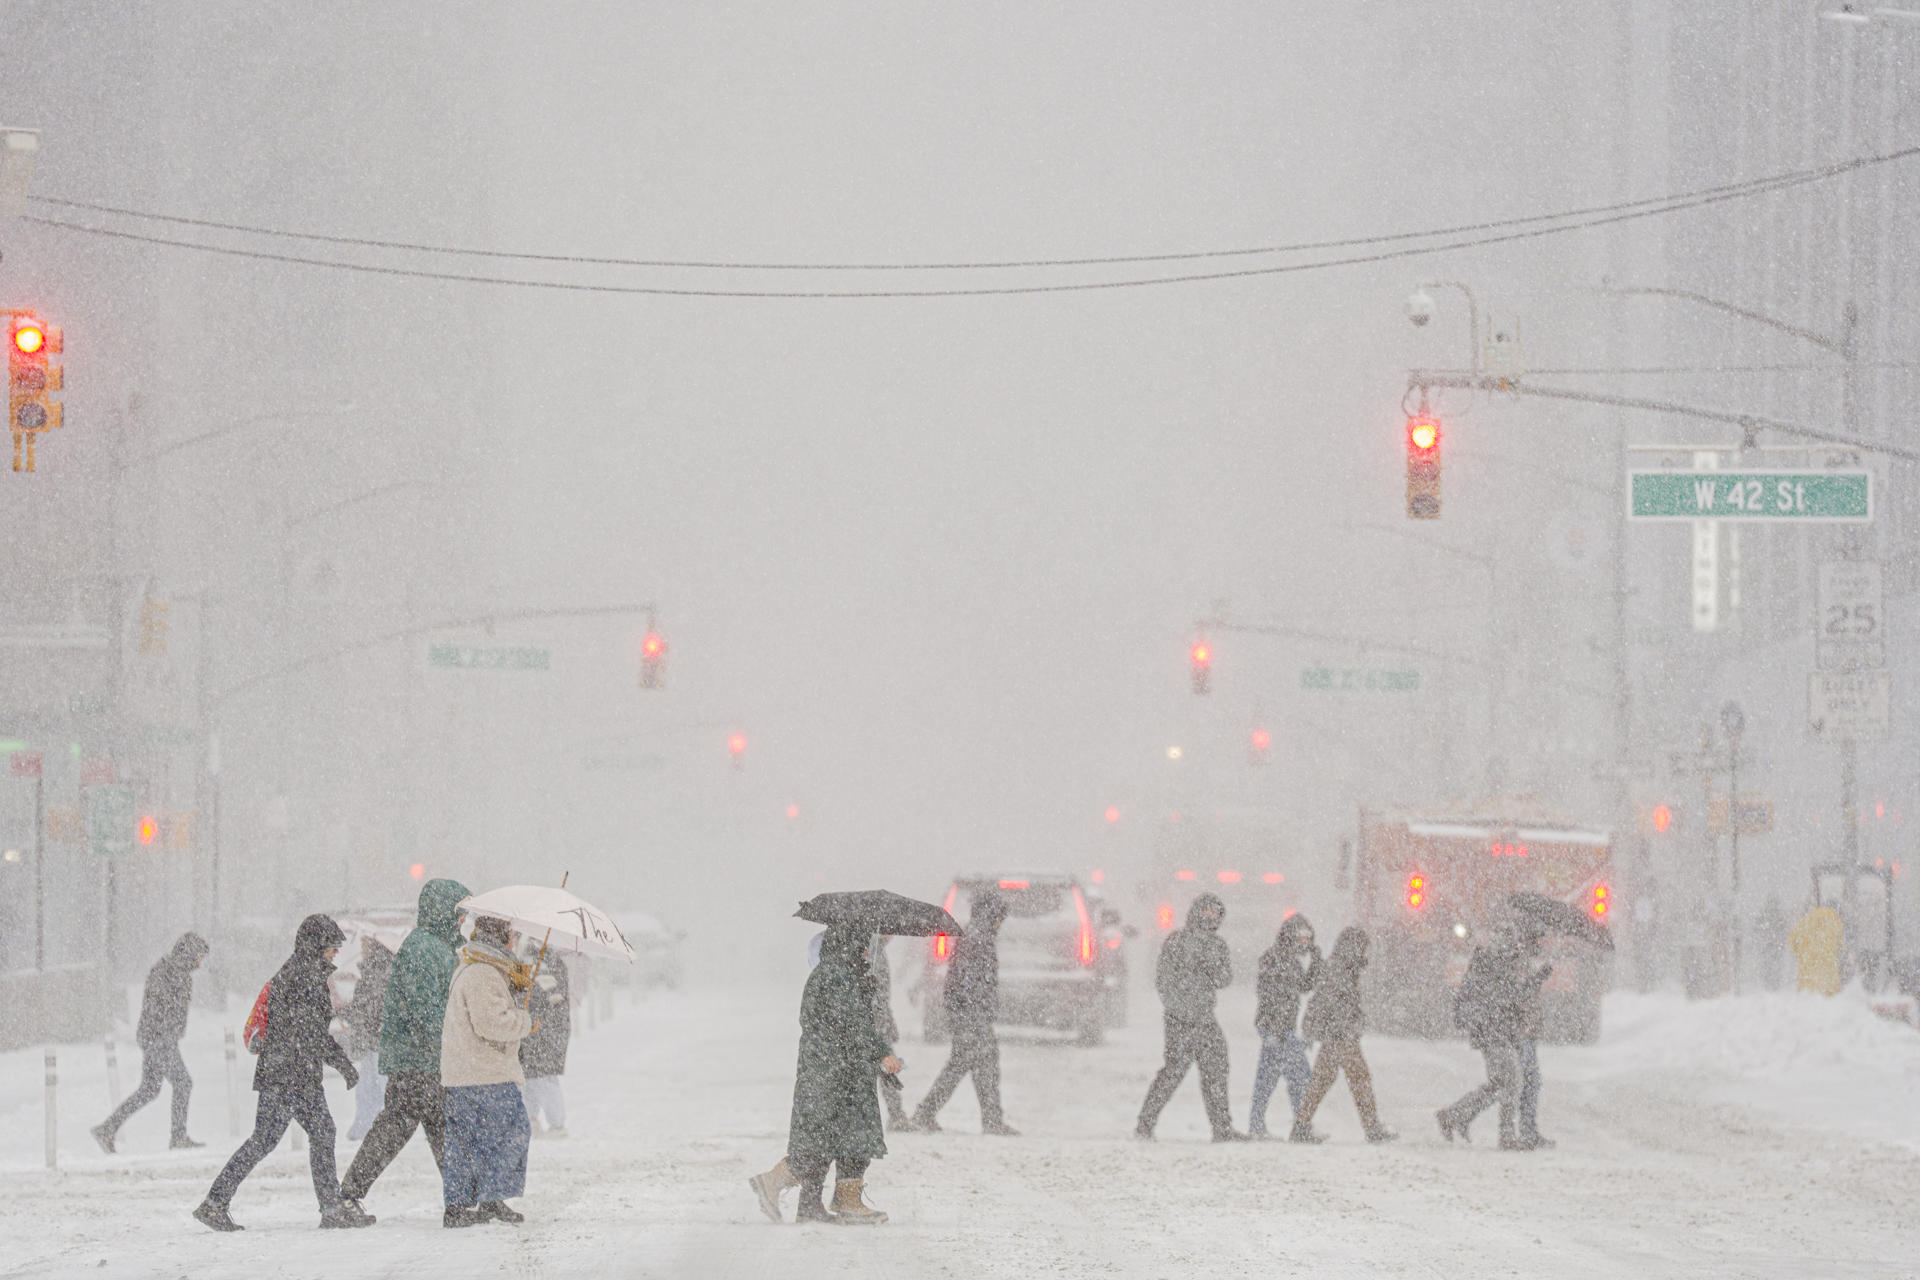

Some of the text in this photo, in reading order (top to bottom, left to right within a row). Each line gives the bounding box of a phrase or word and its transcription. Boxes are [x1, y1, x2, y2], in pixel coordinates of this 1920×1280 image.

[1694, 480, 1805, 510] W 42 St
[1826, 604, 1876, 633] 25
[556, 906, 614, 945] The
